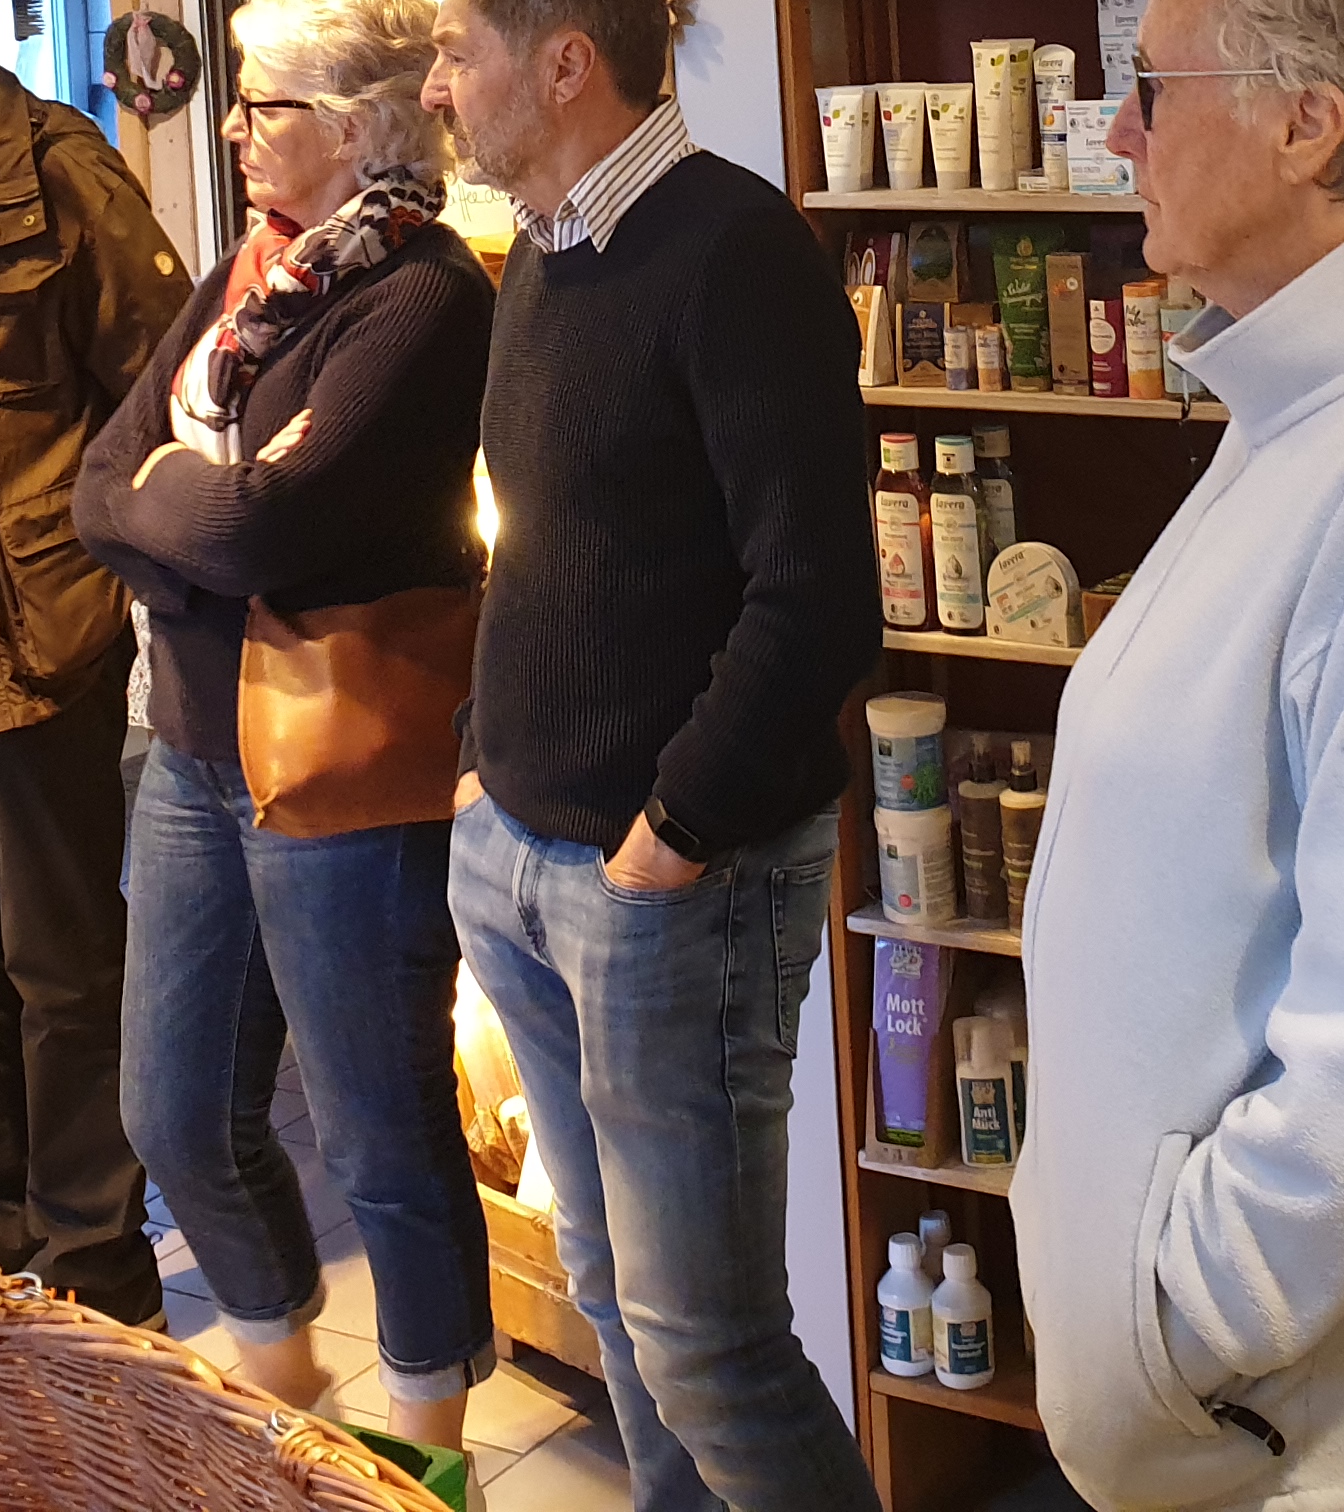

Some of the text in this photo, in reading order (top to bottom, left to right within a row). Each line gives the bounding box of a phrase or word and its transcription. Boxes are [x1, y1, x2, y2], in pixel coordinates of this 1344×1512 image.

[446, 183, 478, 223] affee
[881, 495, 909, 509] lavera
[935, 497, 965, 510] lavera
[998, 550, 1026, 570] lavera
[886, 993, 925, 1016] Mott
[887, 1015, 923, 1036] Lock
[973, 1106, 996, 1120] Anti
